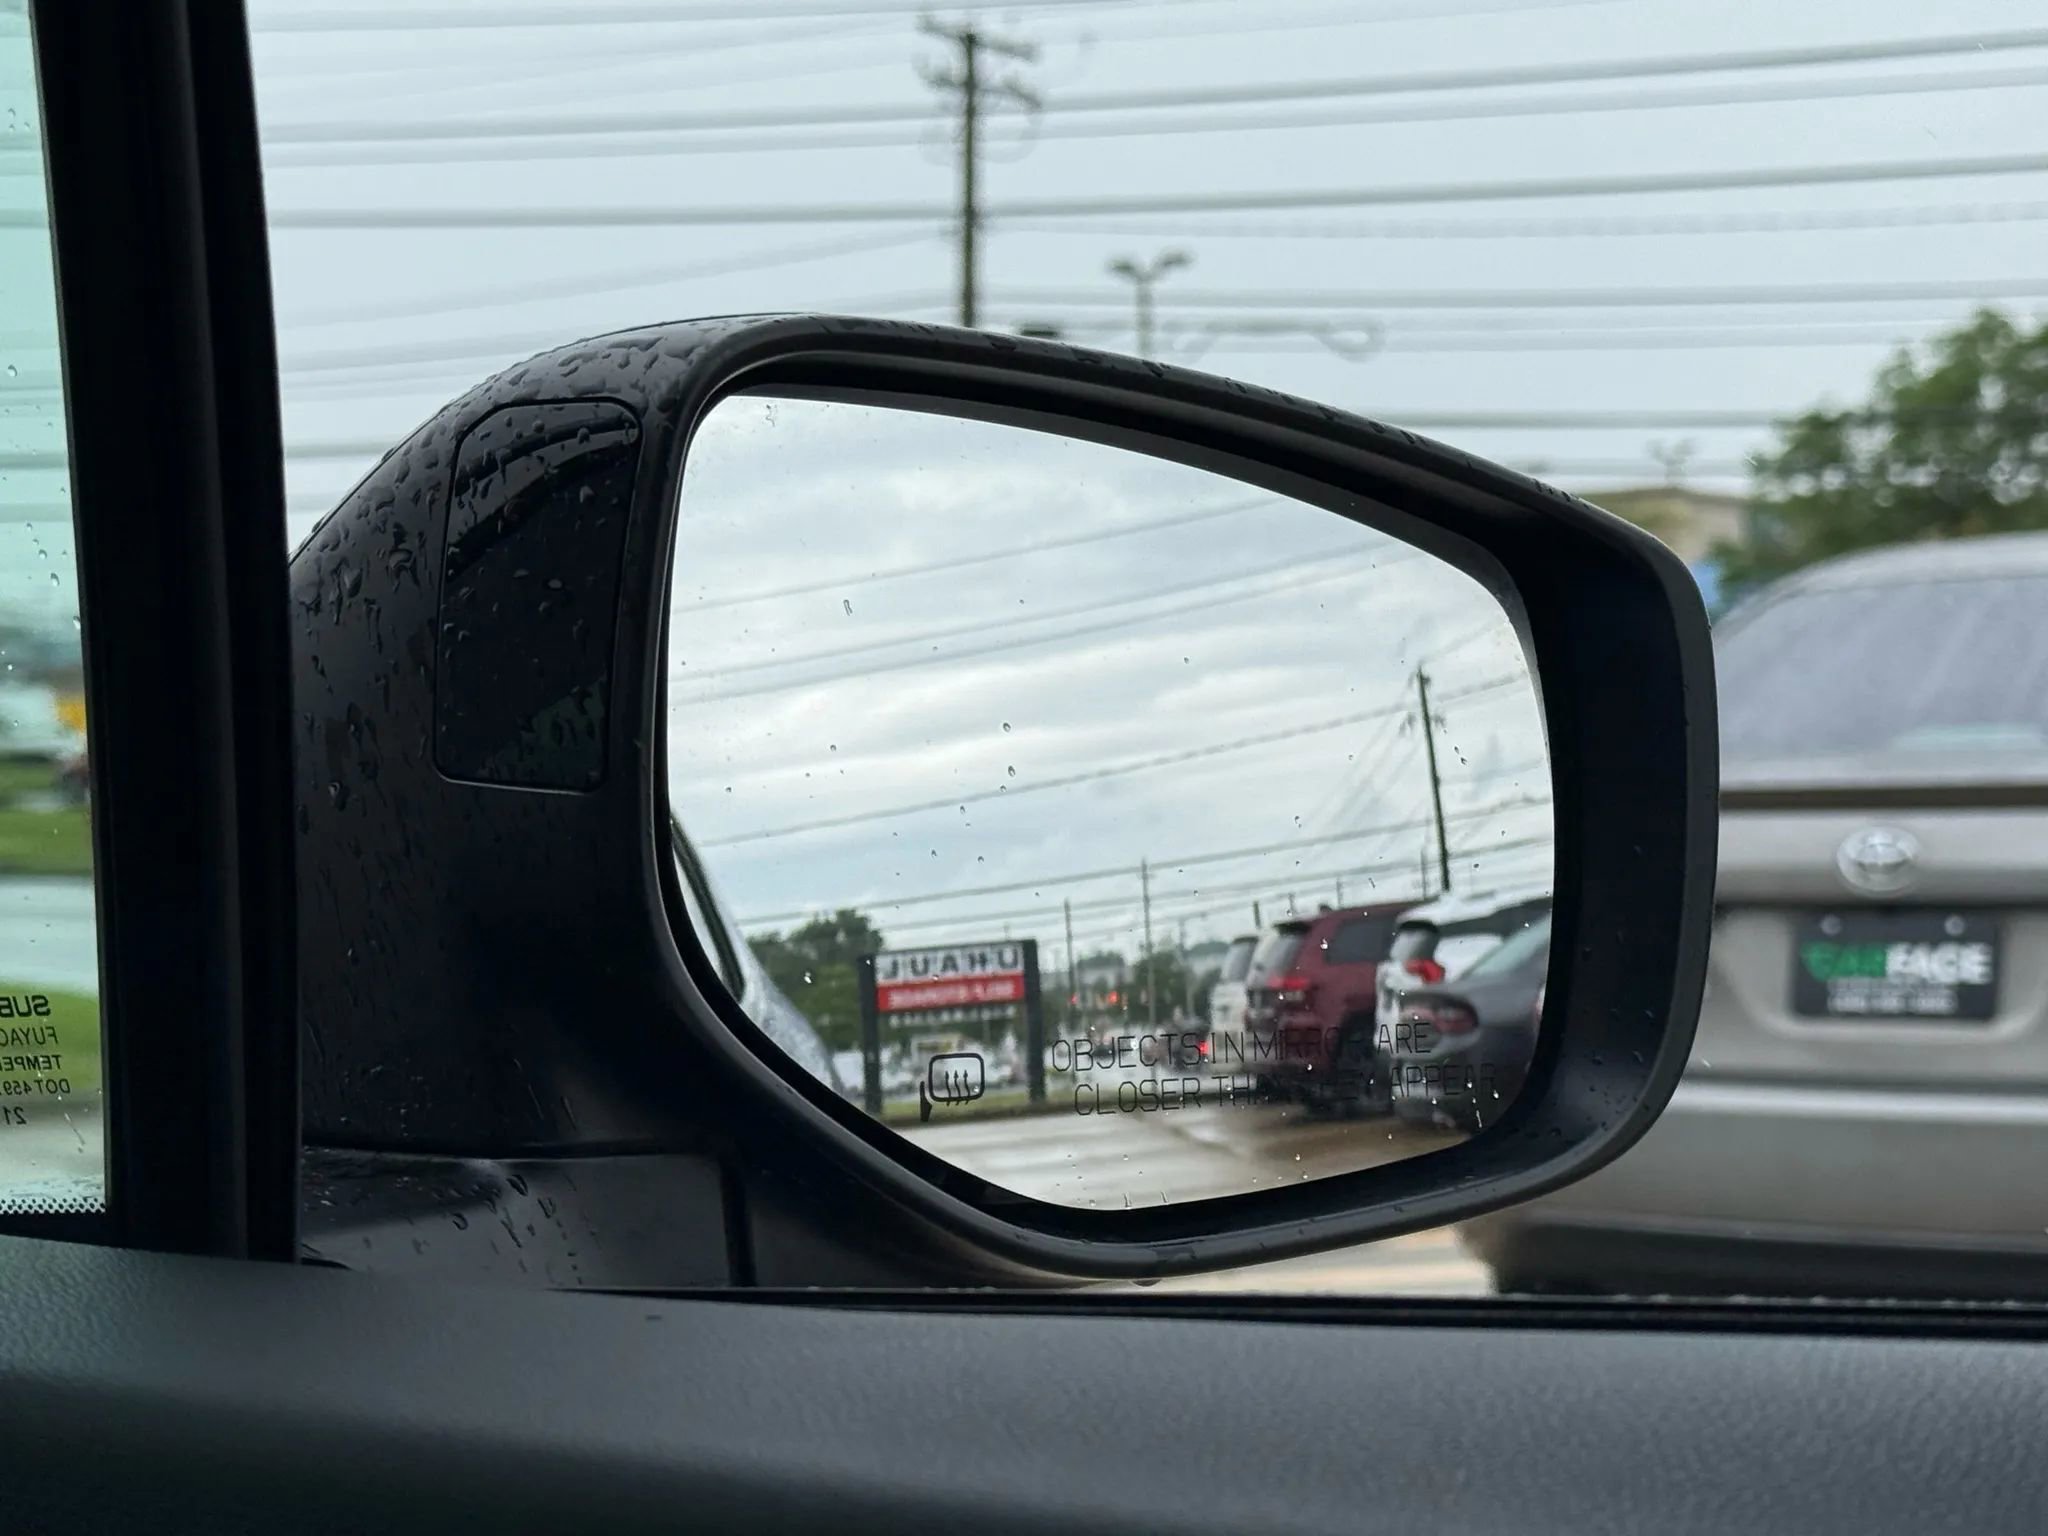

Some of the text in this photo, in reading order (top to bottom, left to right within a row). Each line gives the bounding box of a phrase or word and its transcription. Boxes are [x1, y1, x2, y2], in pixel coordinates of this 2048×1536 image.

[1052, 1022, 1432, 1072] OBJECTS IN MIRRO ARE
[1074, 1077, 1203, 1116] CLOSER
[1391, 1062, 1497, 1098] APPEAR
